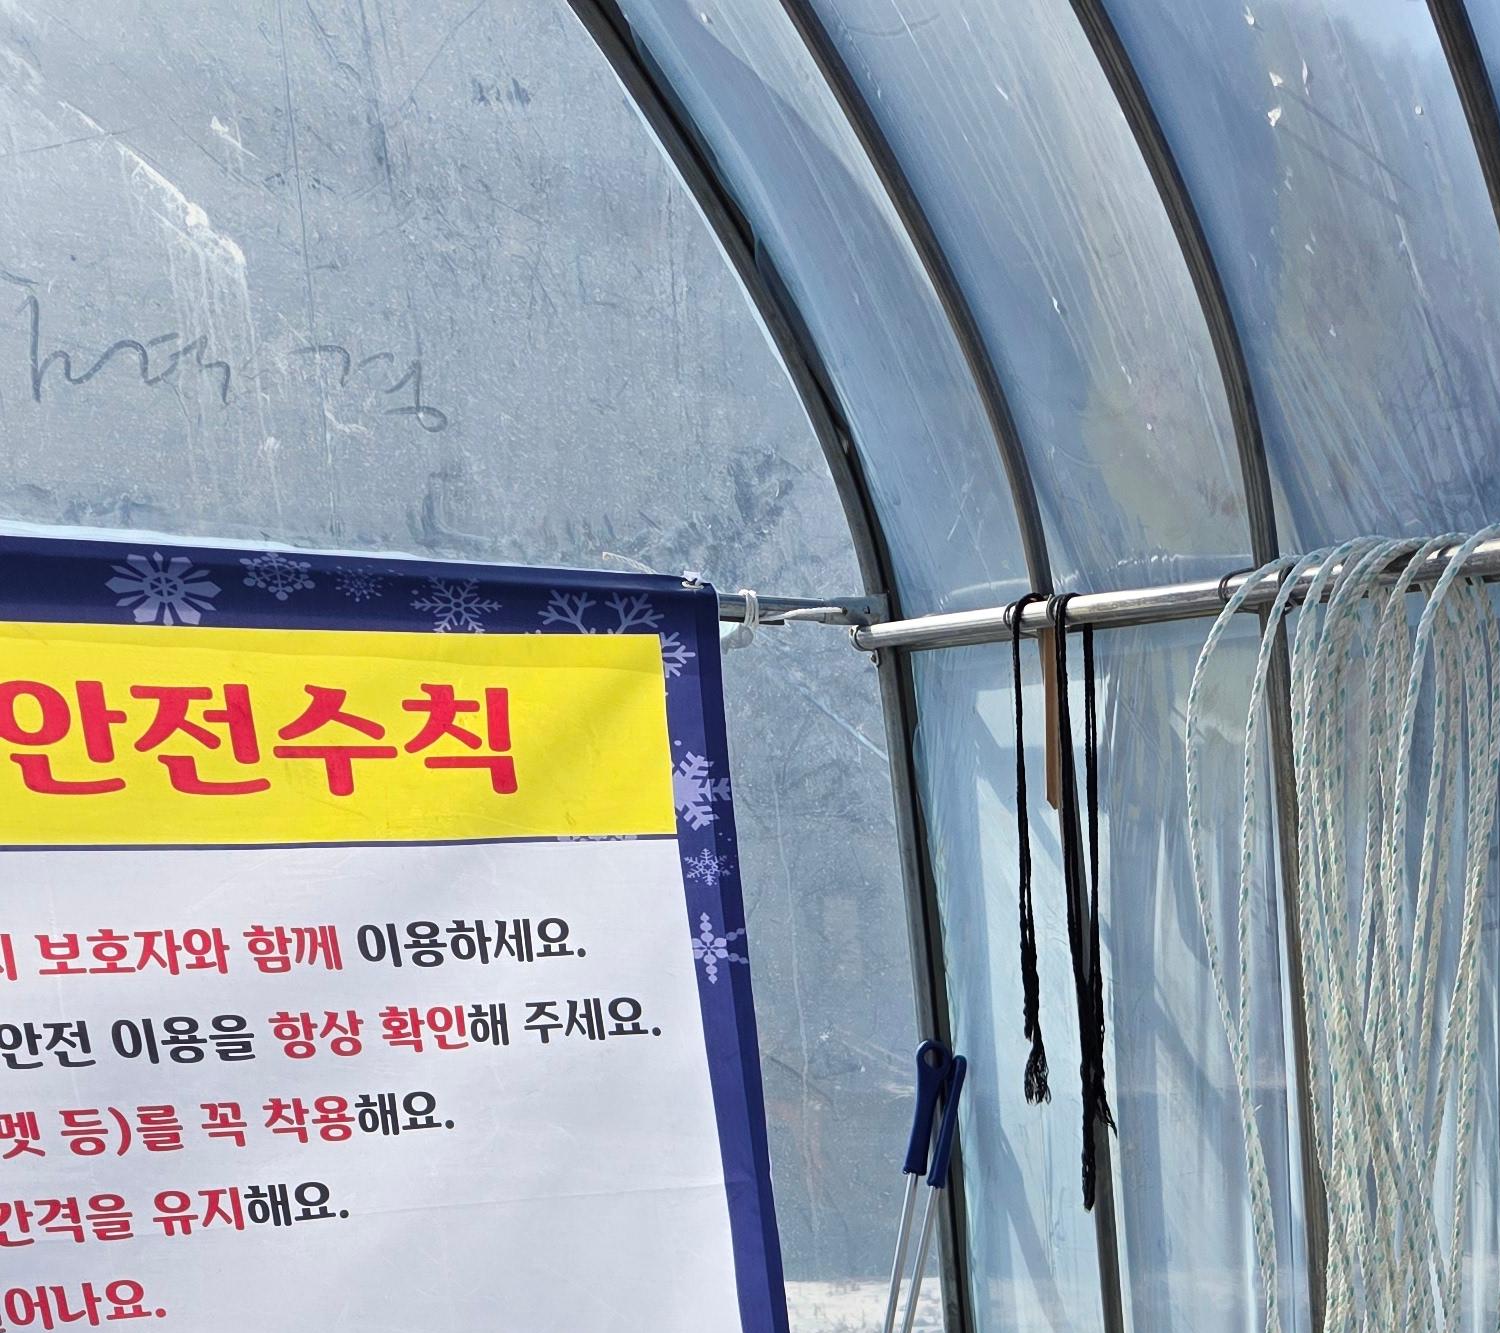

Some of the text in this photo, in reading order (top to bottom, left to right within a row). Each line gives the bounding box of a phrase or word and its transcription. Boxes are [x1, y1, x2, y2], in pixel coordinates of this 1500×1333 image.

[0, 679, 520, 797] 안전수칙
[34, 927, 230, 976] 보호자와
[243, 925, 343, 974] 함께
[357, 917, 586, 968] 이용하세요.
[0, 997, 662, 1070] 안전 이용을 항상 확인해 주세요.
[59, 1104, 184, 1157] 등)를
[200, 1102, 247, 1147] 꼭
[262, 1091, 455, 1144] 착용해요.
[153, 1181, 350, 1236] 유지해요.
[0, 1279, 167, 1333] 어나요.
